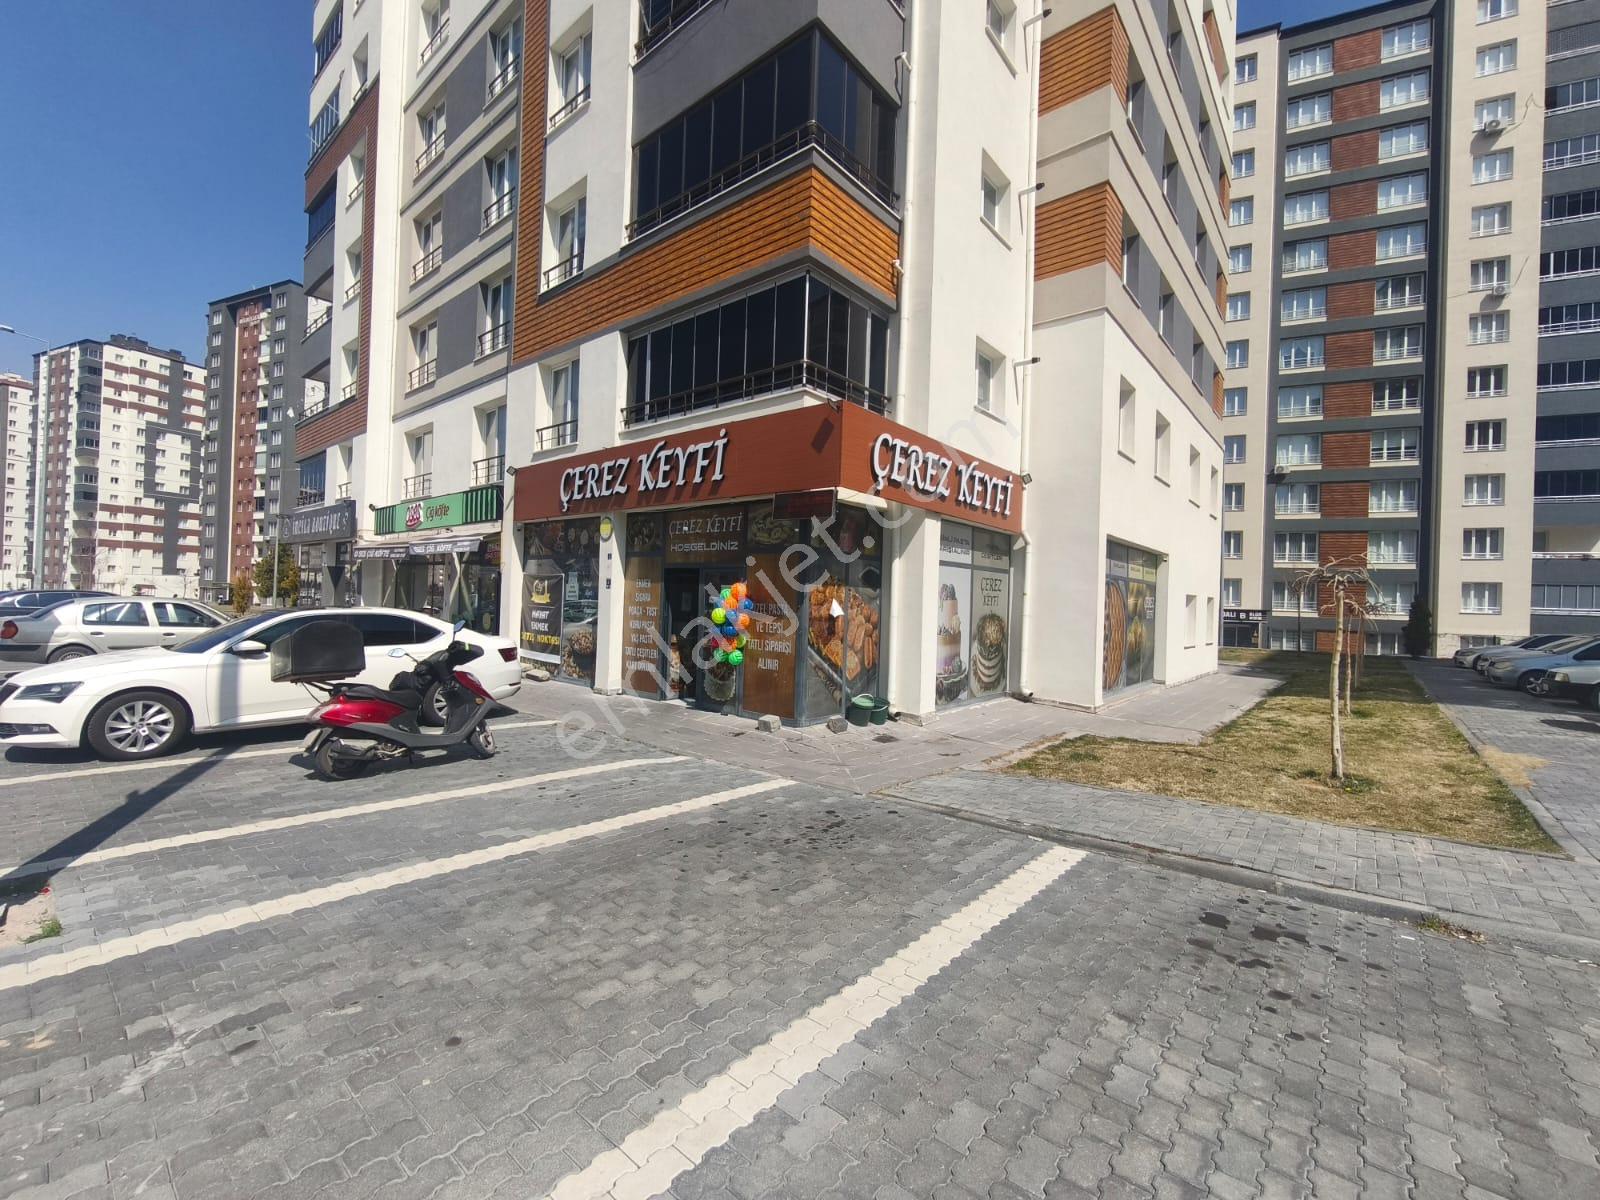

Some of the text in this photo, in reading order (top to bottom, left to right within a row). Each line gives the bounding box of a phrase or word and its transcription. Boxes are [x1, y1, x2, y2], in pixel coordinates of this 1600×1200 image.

[560, 428, 728, 512] ÇEREZ KEYFİ
[873, 433, 1013, 516] ÇEREZ KEYFİ
[669, 512, 743, 539] ÇEREZ KEYFİ
[670, 540, 739, 553] HOŞGELDİNİZ
[747, 639, 763, 651] TATLI
[758, 657, 779, 671] ALINIR
